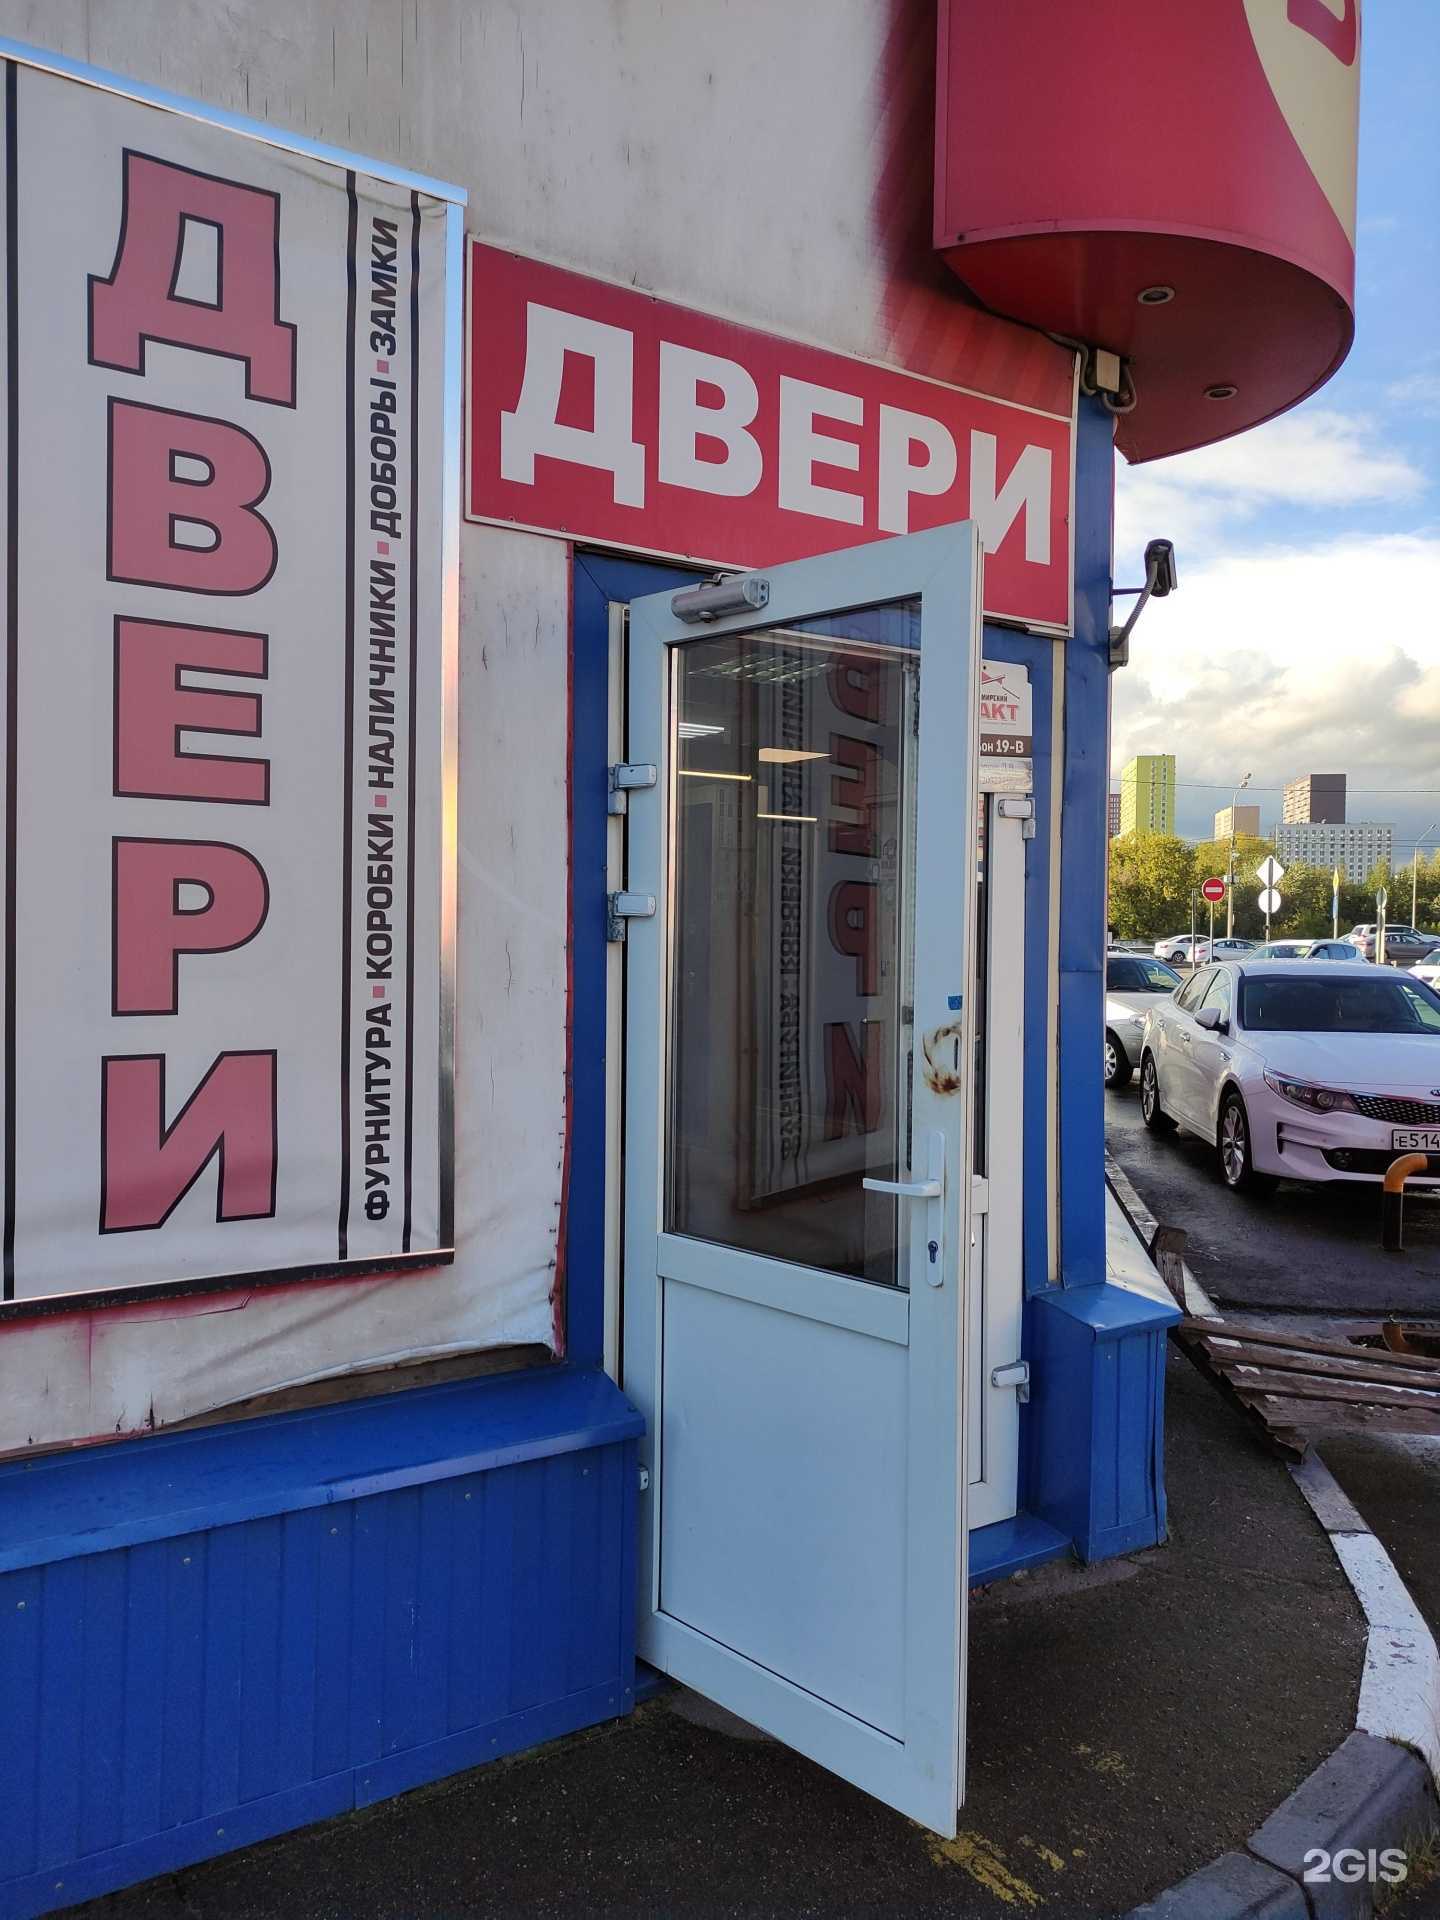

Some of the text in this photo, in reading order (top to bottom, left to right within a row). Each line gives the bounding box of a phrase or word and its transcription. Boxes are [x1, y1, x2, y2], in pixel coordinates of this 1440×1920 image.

[88, 147, 297, 1234] ДВЕРИ
[365, 217, 403, 1221] ФУРНИТУРА КОРОБКИ НАЛИЧНИКИ ДОБОРЫ ЗАМКИ
[500, 301, 1053, 566] ДВЕРИ
